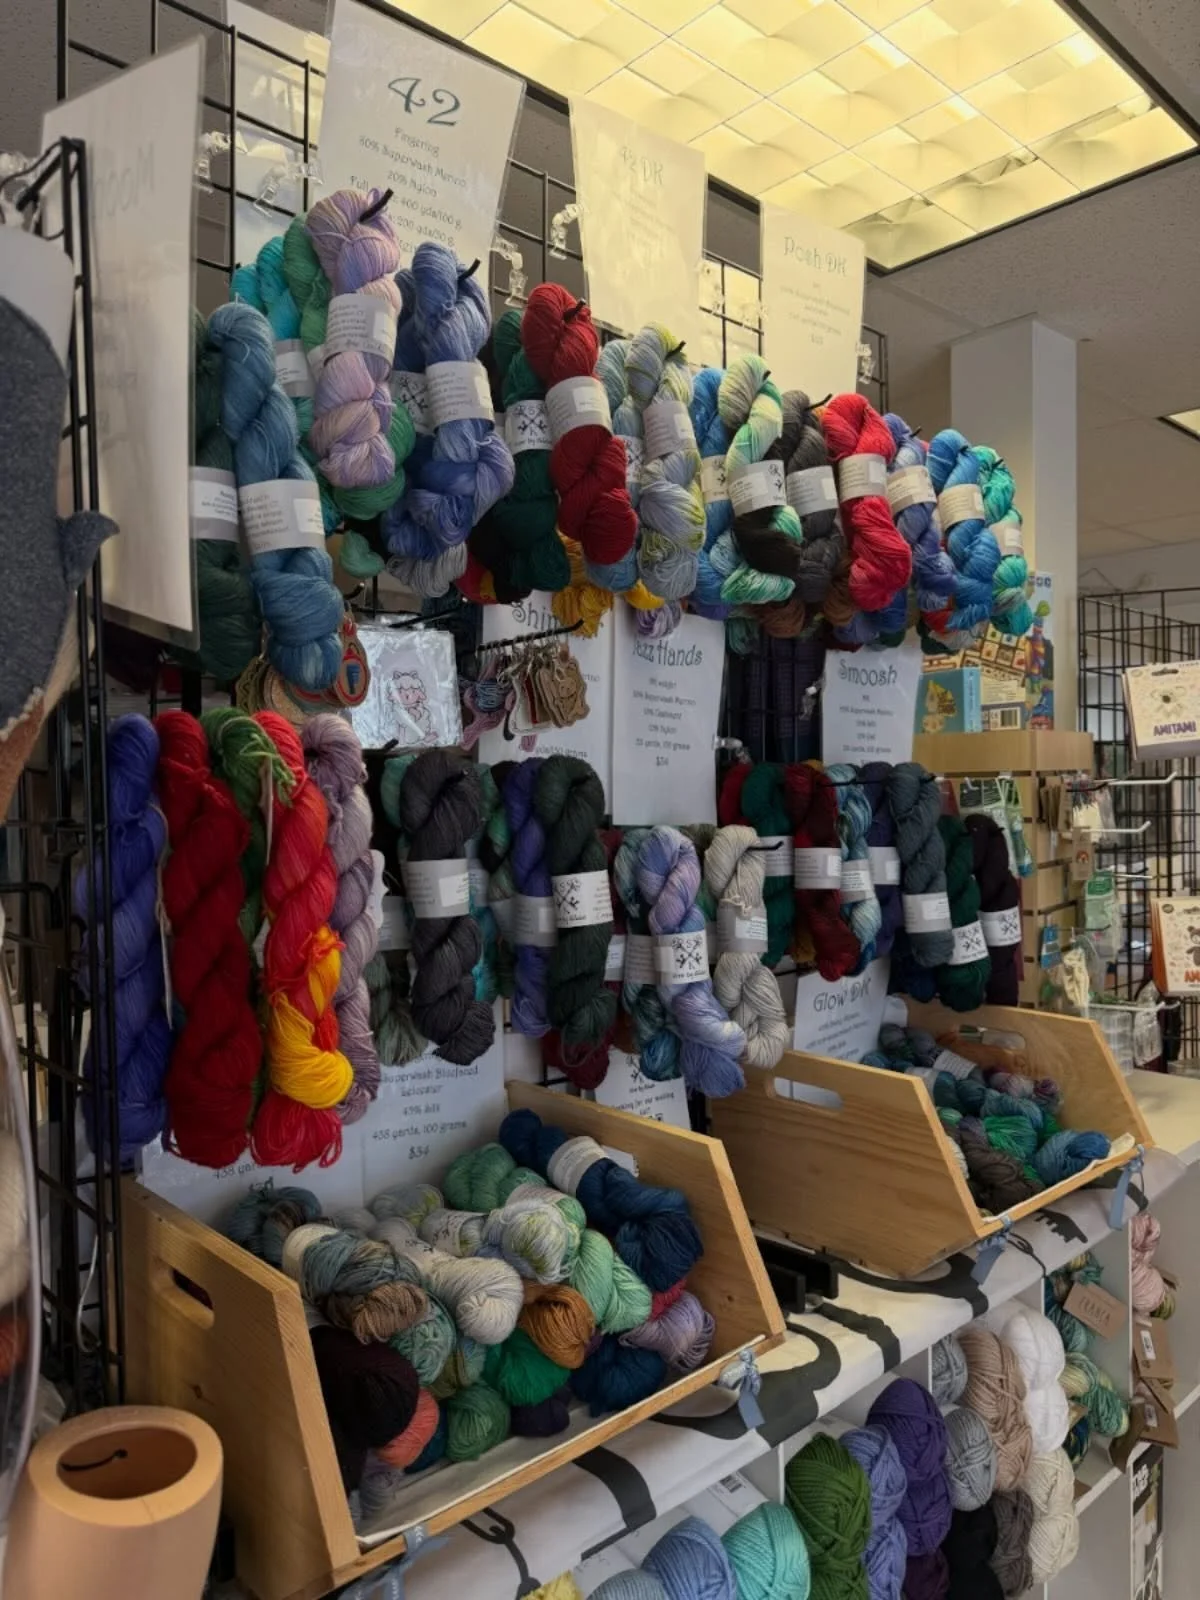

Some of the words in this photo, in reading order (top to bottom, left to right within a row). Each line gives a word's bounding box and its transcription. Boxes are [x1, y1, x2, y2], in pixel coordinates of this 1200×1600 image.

[388, 76, 461, 126] 42
[783, 236, 823, 272] Posh
[655, 639, 703, 667] Hands
[838, 659, 897, 687] Smoosh
[1153, 721, 1196, 736] AMITAMI
[813, 990, 847, 1012] Glow
[372, 1128, 390, 1140] 438
[424, 1122, 438, 1134] 100
[439, 1120, 467, 1133] grams
